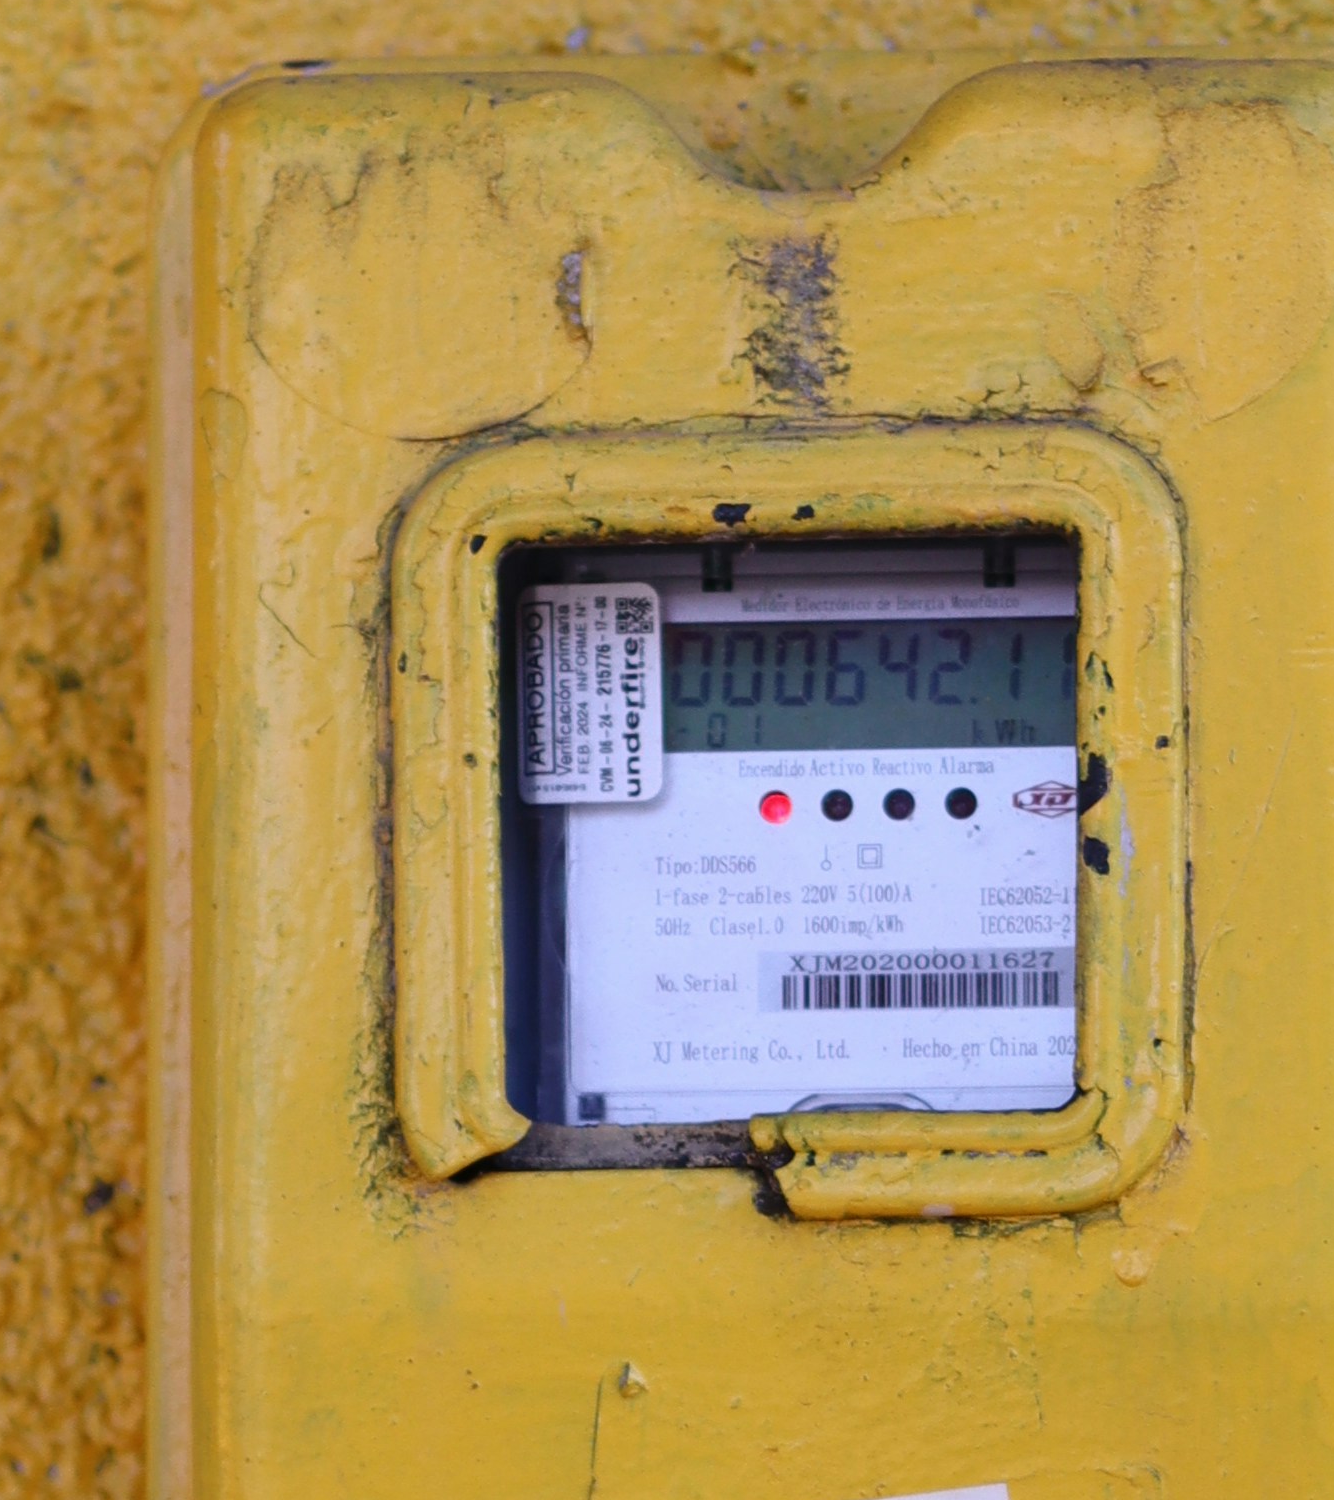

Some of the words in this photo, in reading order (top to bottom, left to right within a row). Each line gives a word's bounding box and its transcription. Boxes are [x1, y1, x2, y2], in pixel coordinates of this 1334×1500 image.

[876, 596, 891, 610] de
[557, 604, 574, 673] primaria
[575, 623, 589, 692] INFORME
[526, 612, 545, 765] APROBADO
[554, 678, 572, 776] Verificación
[577, 701, 589, 736] 2024
[620, 637, 642, 798] underfire
[738, 758, 805, 778] Encendido
[810, 756, 866, 777] Activo
[872, 756, 933, 775] Reactivo
[939, 754, 995, 775] Alarma
[718, 887, 792, 903] 2-cables
[801, 886, 838, 903] 220V
[980, 887, 1075, 906] IEC62052-1
[654, 918, 691, 936] 50Hz
[980, 915, 1075, 934] IEC62053-2
[790, 951, 1055, 974] XJM202000011627
[653, 1041, 671, 1064] XJ
[681, 1041, 759, 1063] Metering
[816, 1038, 851, 1060] Ltd.
[902, 1037, 951, 1058] Hecho
[960, 1042, 980, 1058] en
[990, 1035, 1038, 1057] China
